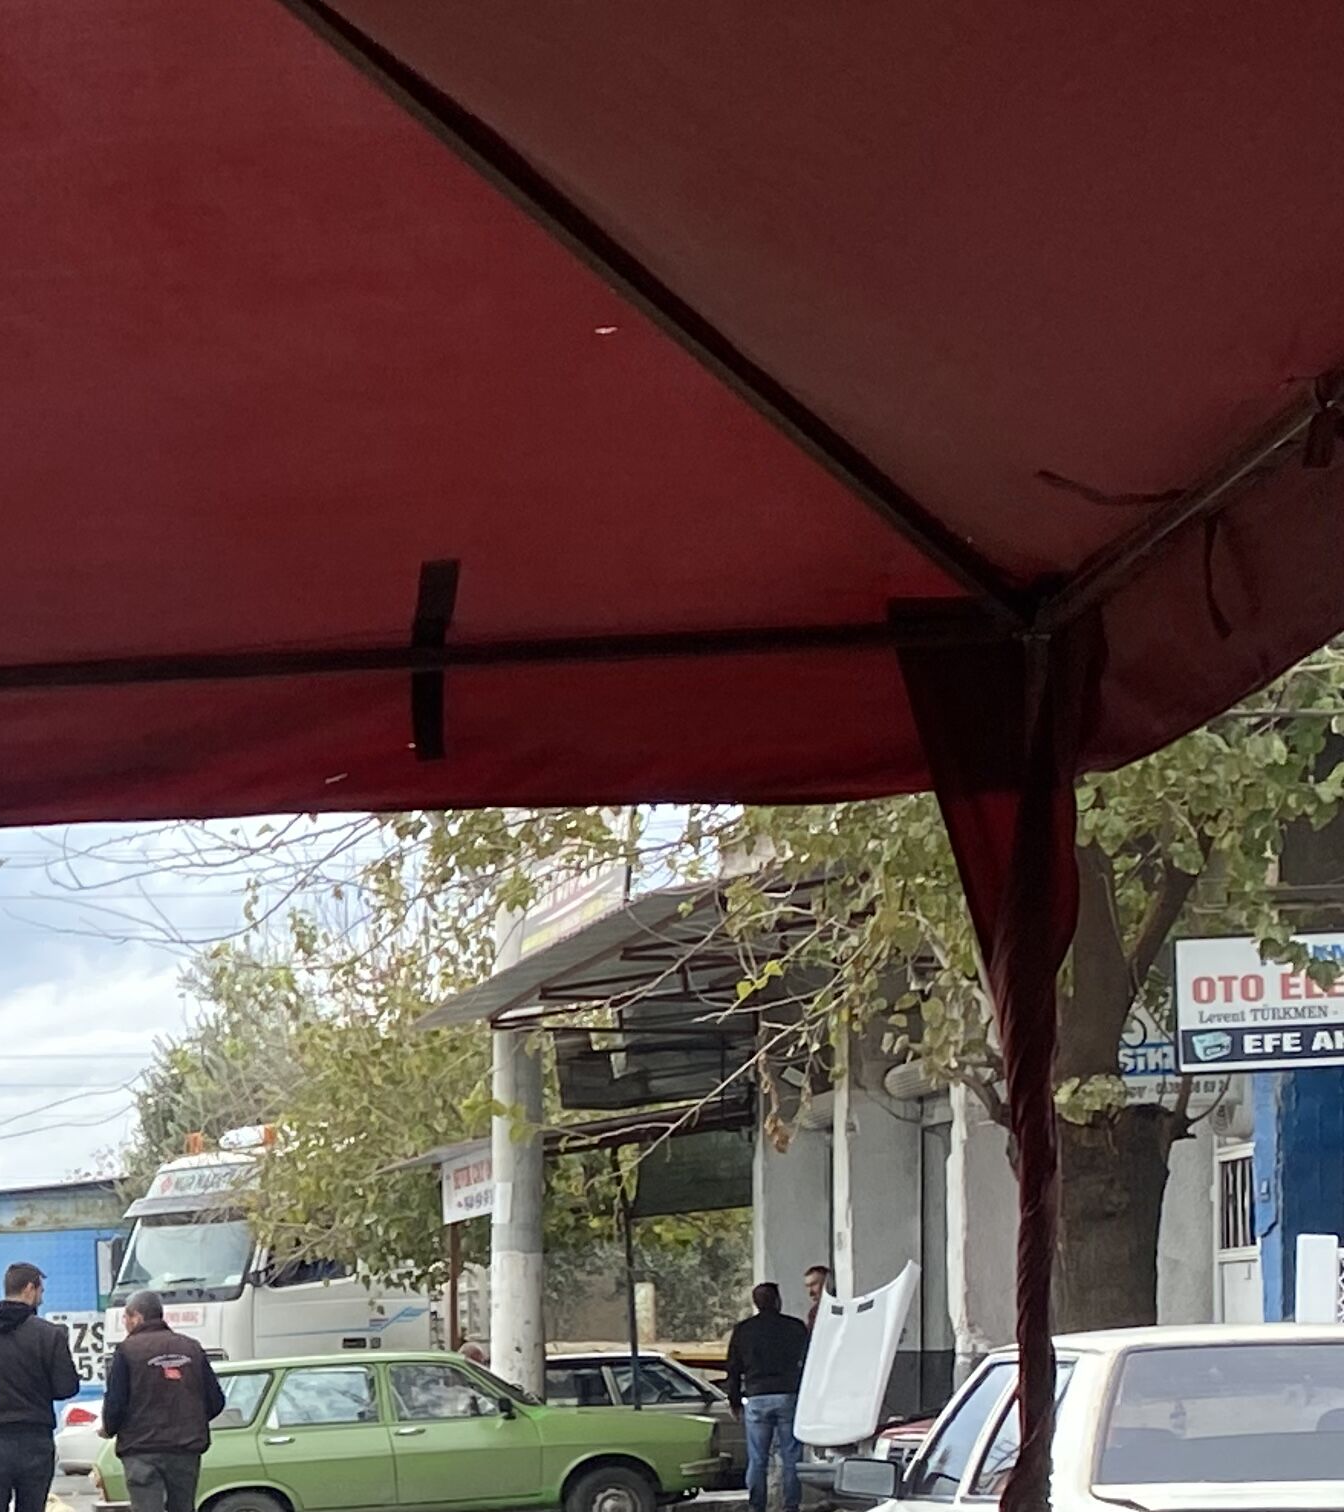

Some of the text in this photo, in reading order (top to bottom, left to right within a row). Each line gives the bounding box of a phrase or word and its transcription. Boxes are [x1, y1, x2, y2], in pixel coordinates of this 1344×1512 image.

[1192, 974, 1265, 1004] OTO
[1250, 1003, 1328, 1022] TÜRKMEN
[1243, 1032, 1302, 1054] EFE
